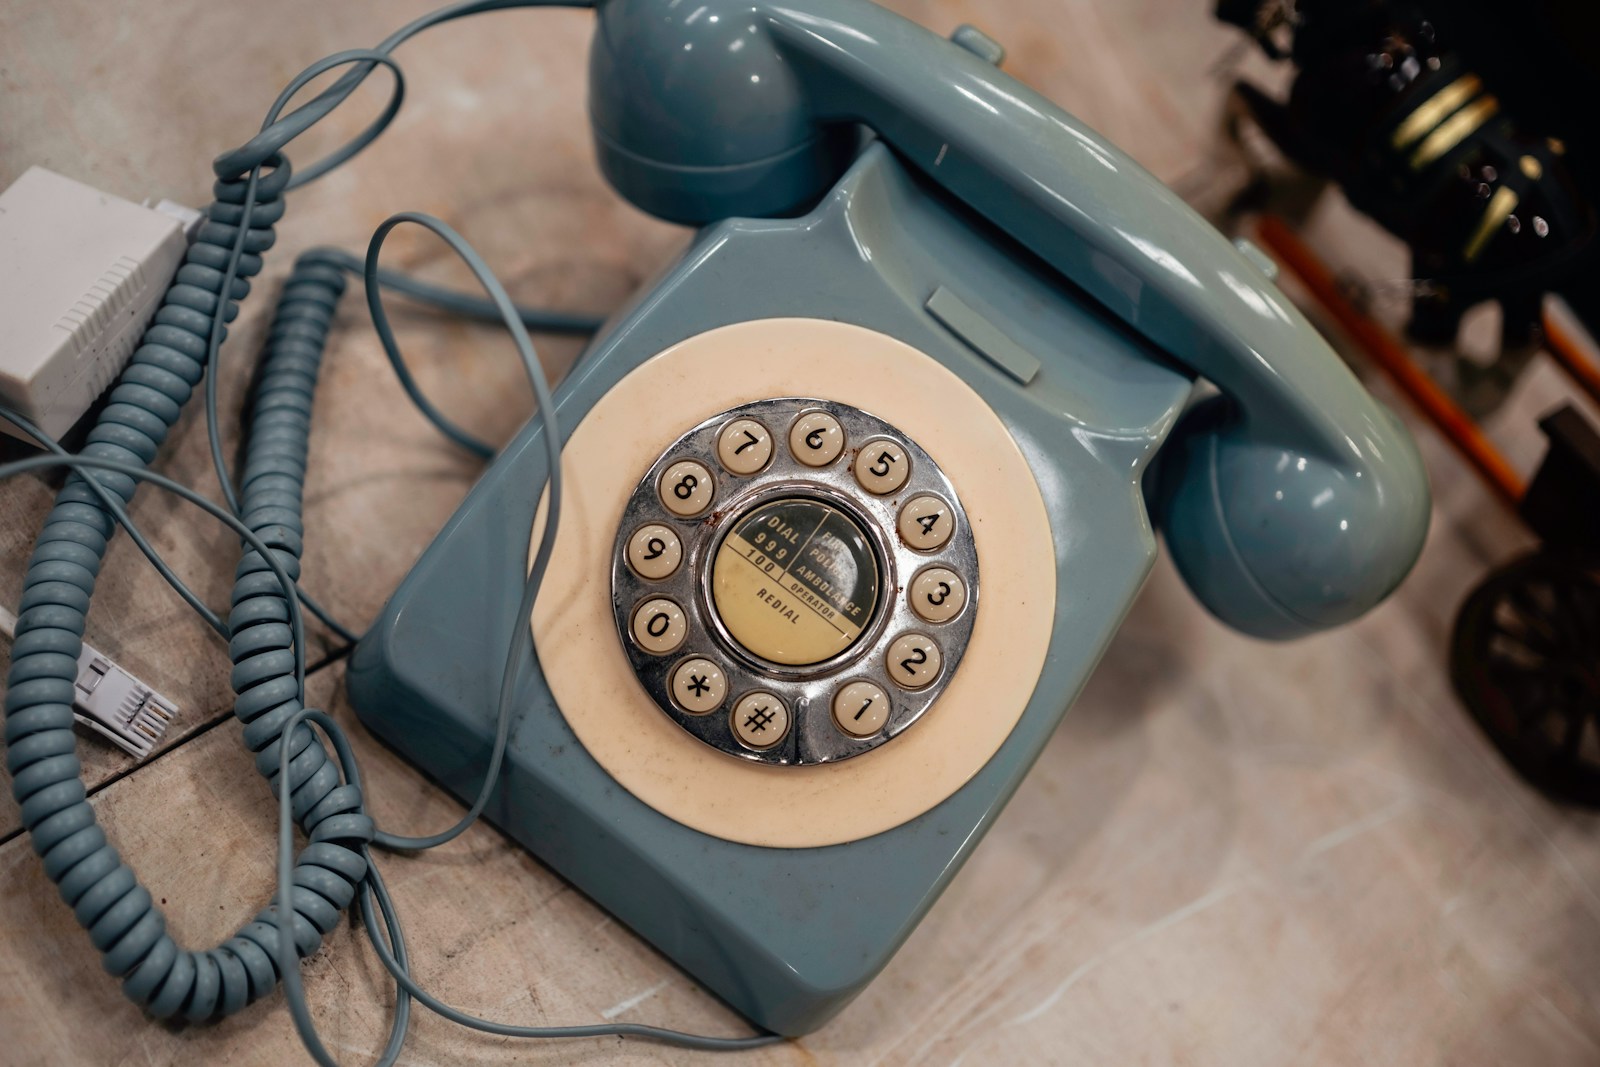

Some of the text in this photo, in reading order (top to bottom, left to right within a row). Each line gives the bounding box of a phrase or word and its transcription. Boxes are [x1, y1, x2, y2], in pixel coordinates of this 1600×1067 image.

[734, 431, 759, 455] 7
[805, 428, 826, 450] 6
[869, 451, 896, 477] 5
[674, 474, 698, 499] 8
[768, 516, 800, 544] DIAL
[916, 512, 939, 535] 4
[644, 538, 666, 560] 9
[754, 533, 788, 560] 999
[746, 549, 775, 573] 100
[809, 549, 847, 579] POLICE
[791, 583, 836, 619] OPERATOR
[796, 566, 861, 617] AMBULANCE
[927, 582, 950, 605] 3
[757, 588, 799, 624] REDIAL
[647, 612, 670, 637] 0
[901, 648, 927, 675] 2
[744, 706, 776, 732] #
[854, 698, 872, 721] 1
